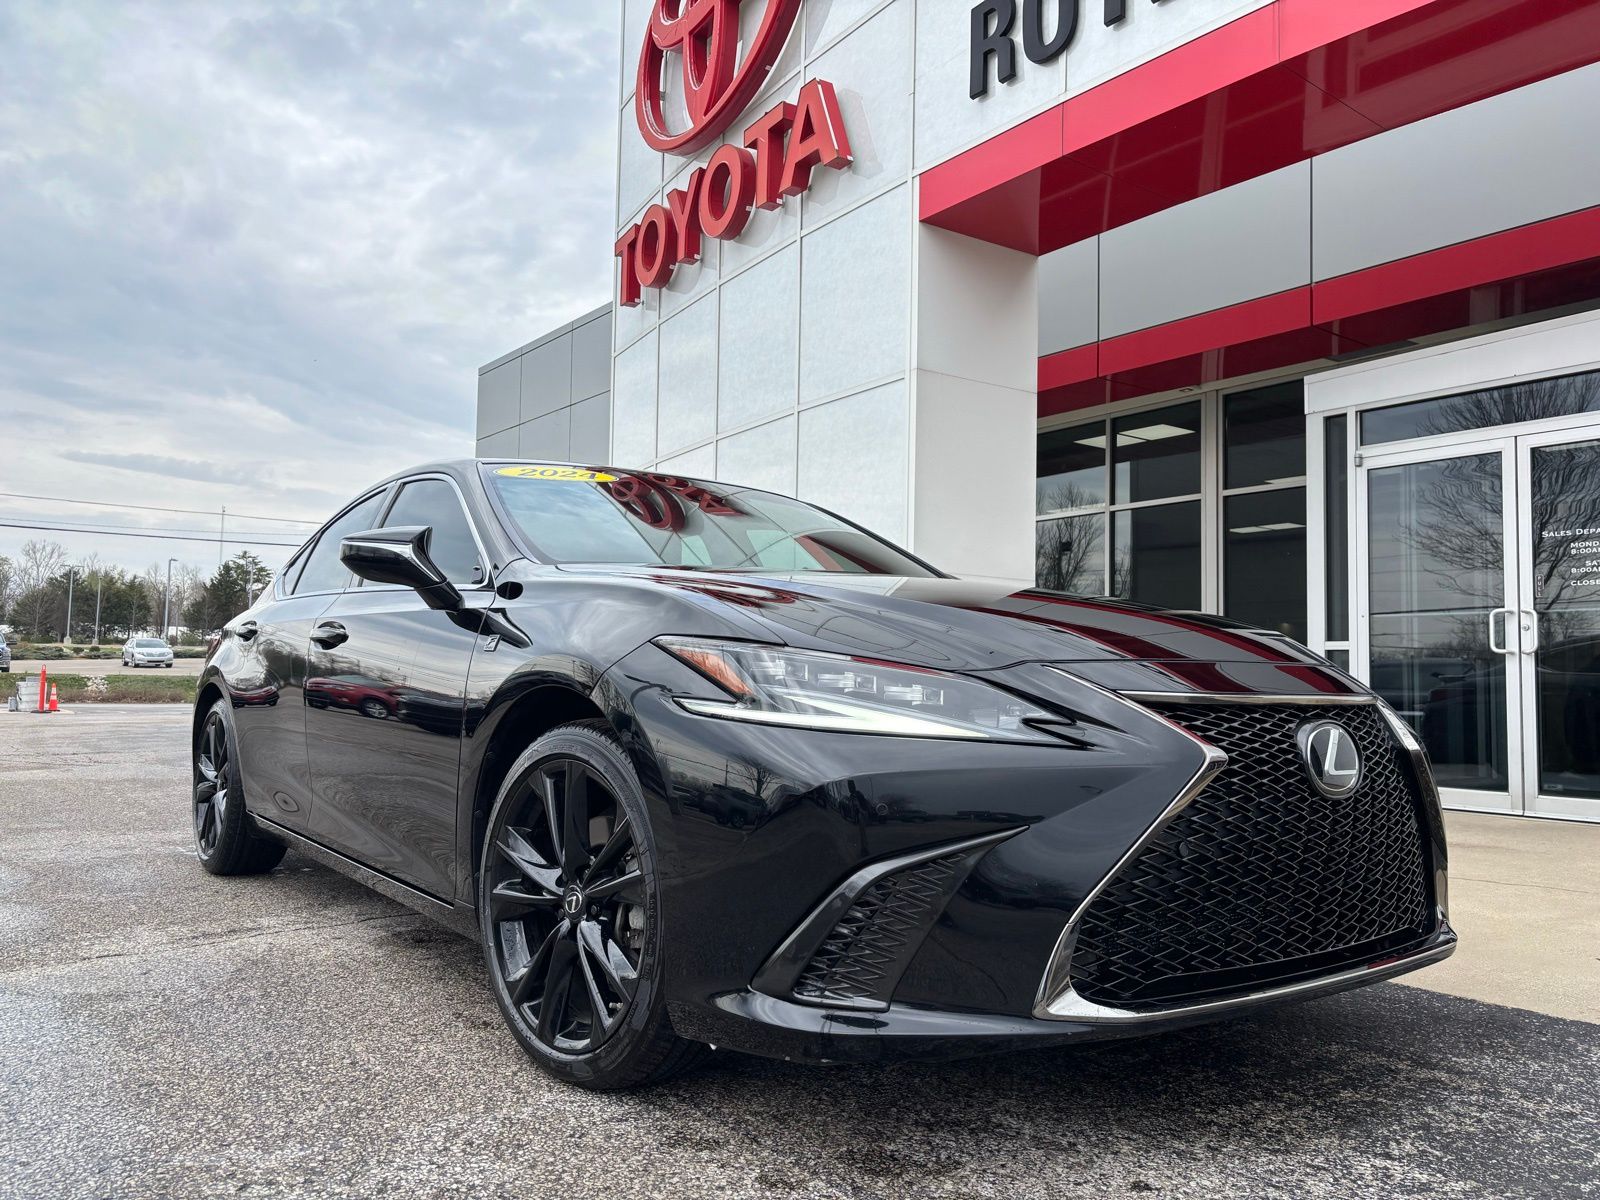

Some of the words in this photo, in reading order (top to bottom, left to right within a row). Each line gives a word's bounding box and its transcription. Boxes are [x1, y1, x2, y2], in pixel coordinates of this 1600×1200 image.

[969, 0, 1164, 99] RO
[614, 77, 853, 307] TOYOTA
[518, 468, 598, 480] 2024
